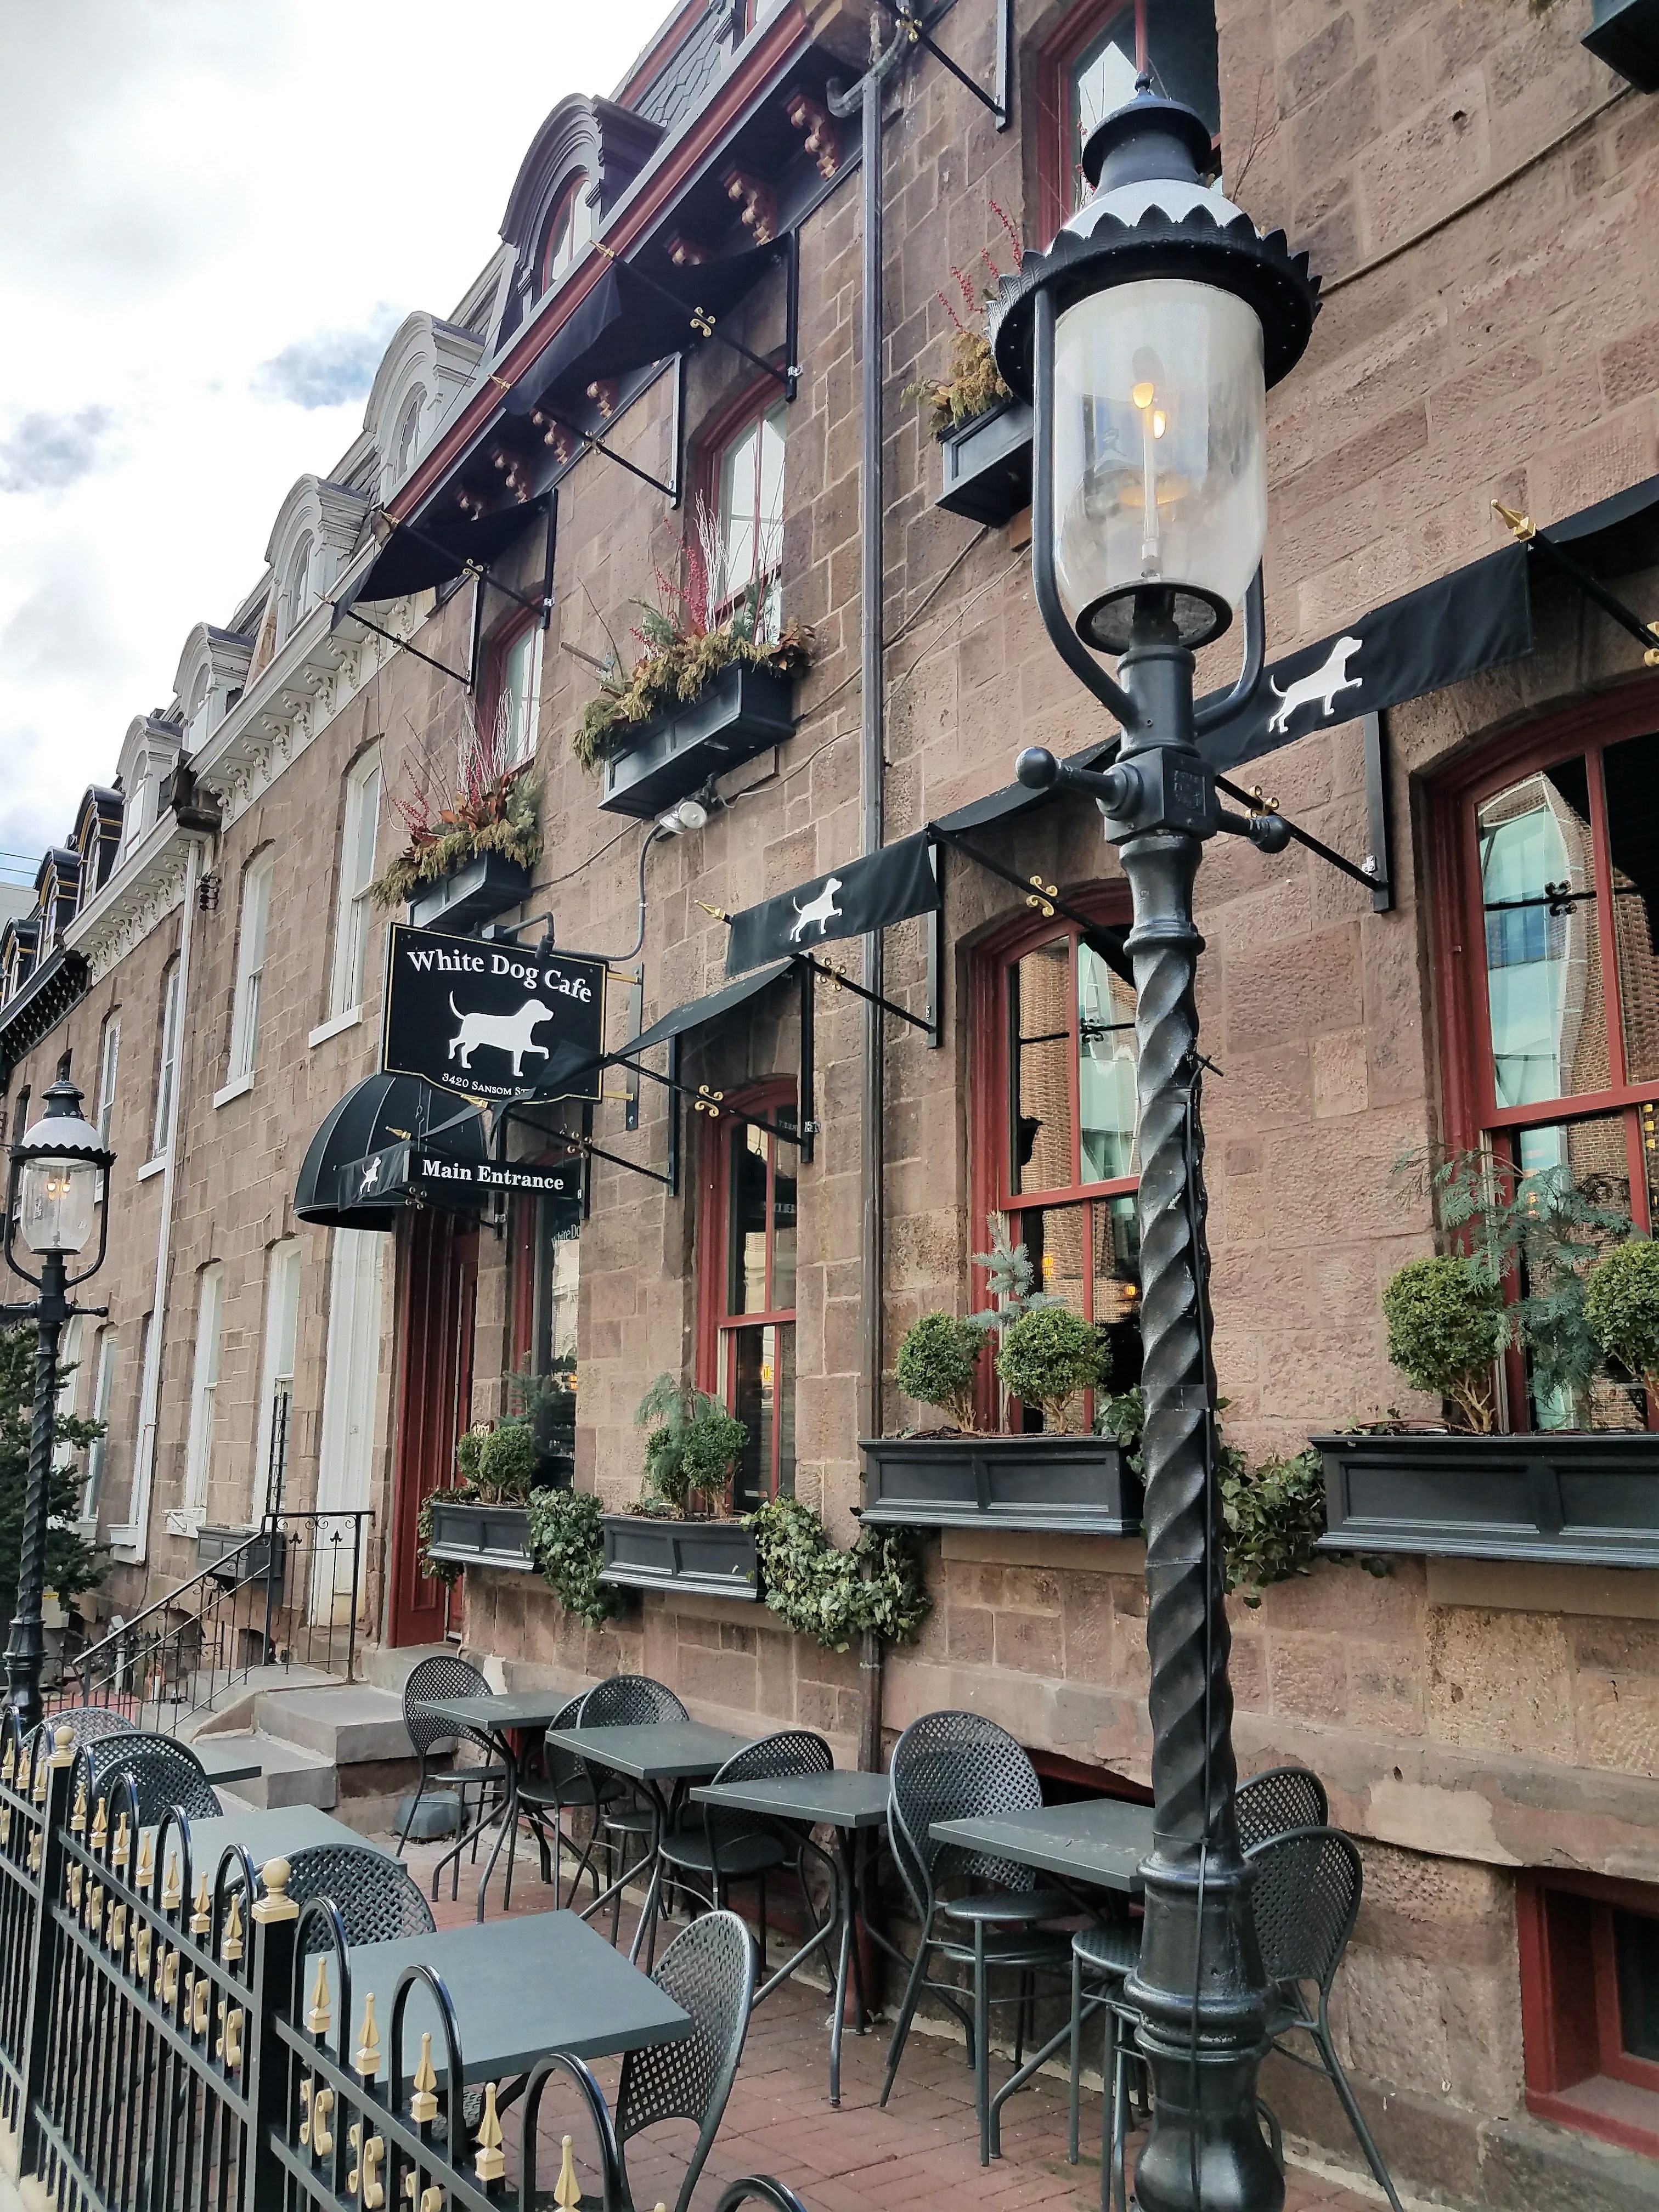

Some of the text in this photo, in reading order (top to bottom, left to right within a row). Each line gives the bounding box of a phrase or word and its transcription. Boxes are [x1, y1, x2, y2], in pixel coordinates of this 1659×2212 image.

[407, 949, 592, 1003] White Dog Cafe
[442, 1073, 469, 1088] 3420
[421, 1159, 565, 1190] Main Entrance
